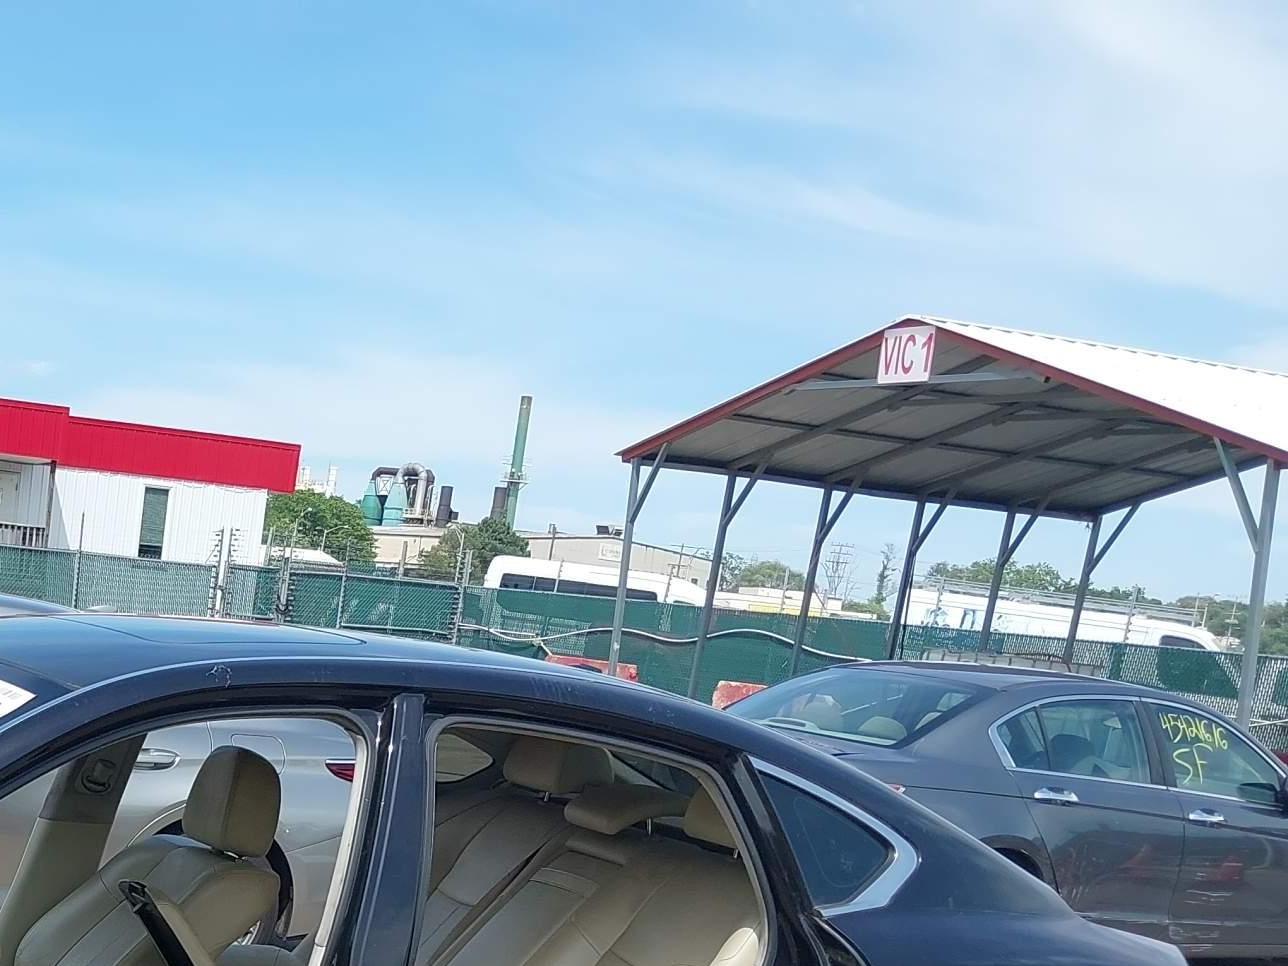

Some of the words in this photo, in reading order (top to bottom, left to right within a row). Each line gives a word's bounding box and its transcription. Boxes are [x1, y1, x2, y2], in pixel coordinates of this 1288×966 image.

[884, 334, 916, 375] VIC
[921, 332, 933, 372] 1
[1173, 743, 1214, 784] SF
